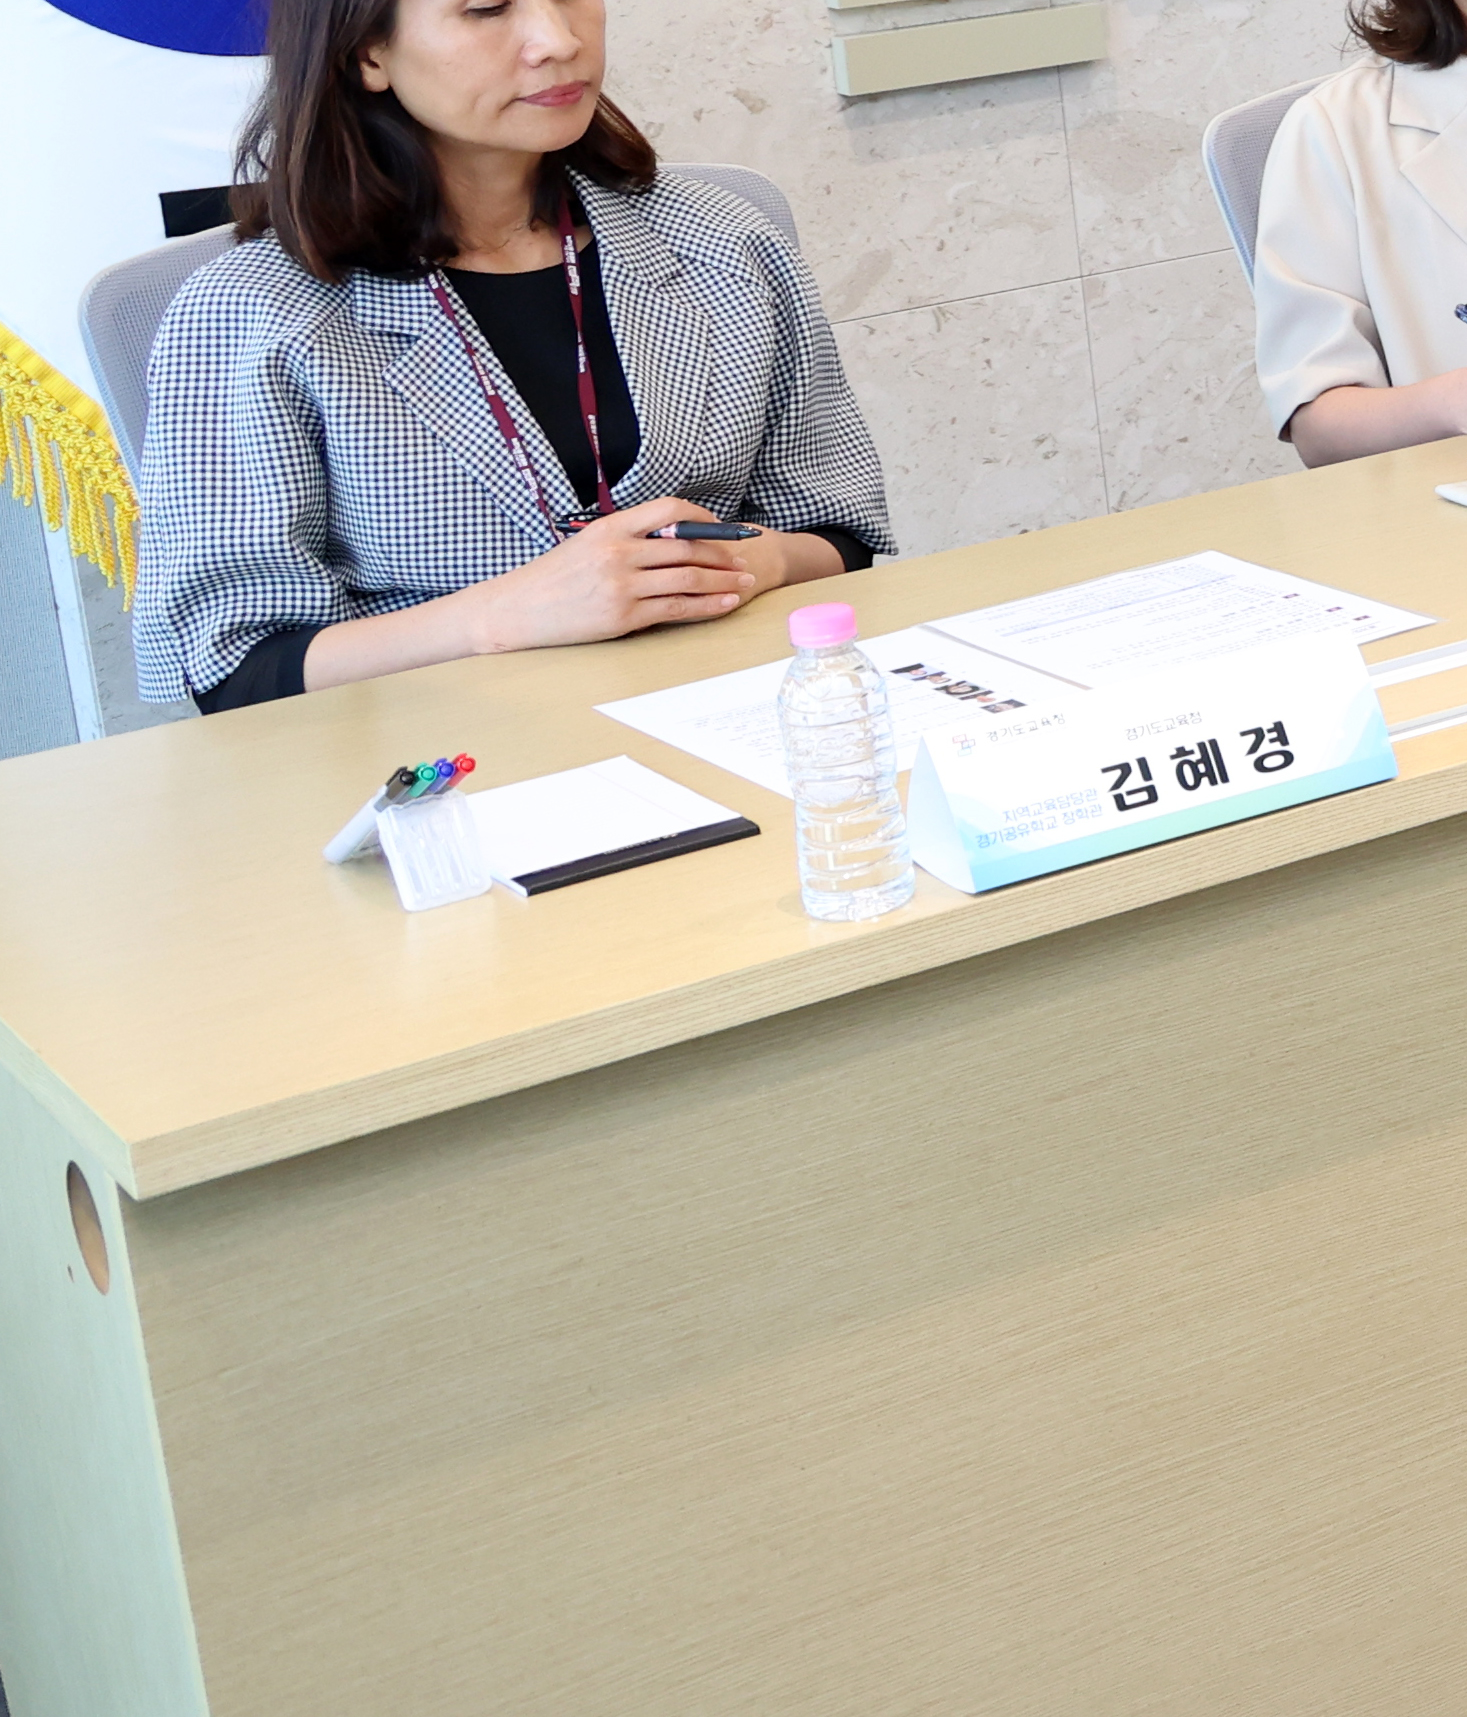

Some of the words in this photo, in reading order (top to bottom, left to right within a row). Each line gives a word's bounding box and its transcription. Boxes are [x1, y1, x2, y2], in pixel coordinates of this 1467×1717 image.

[986, 713, 1067, 742] 경기도교육청
[1125, 711, 1203, 741] 경기도교육청
[1101, 720, 1296, 813] 김혜경
[1003, 787, 1099, 823] 지역교육담당관
[976, 814, 1060, 849] 경기공유학교
